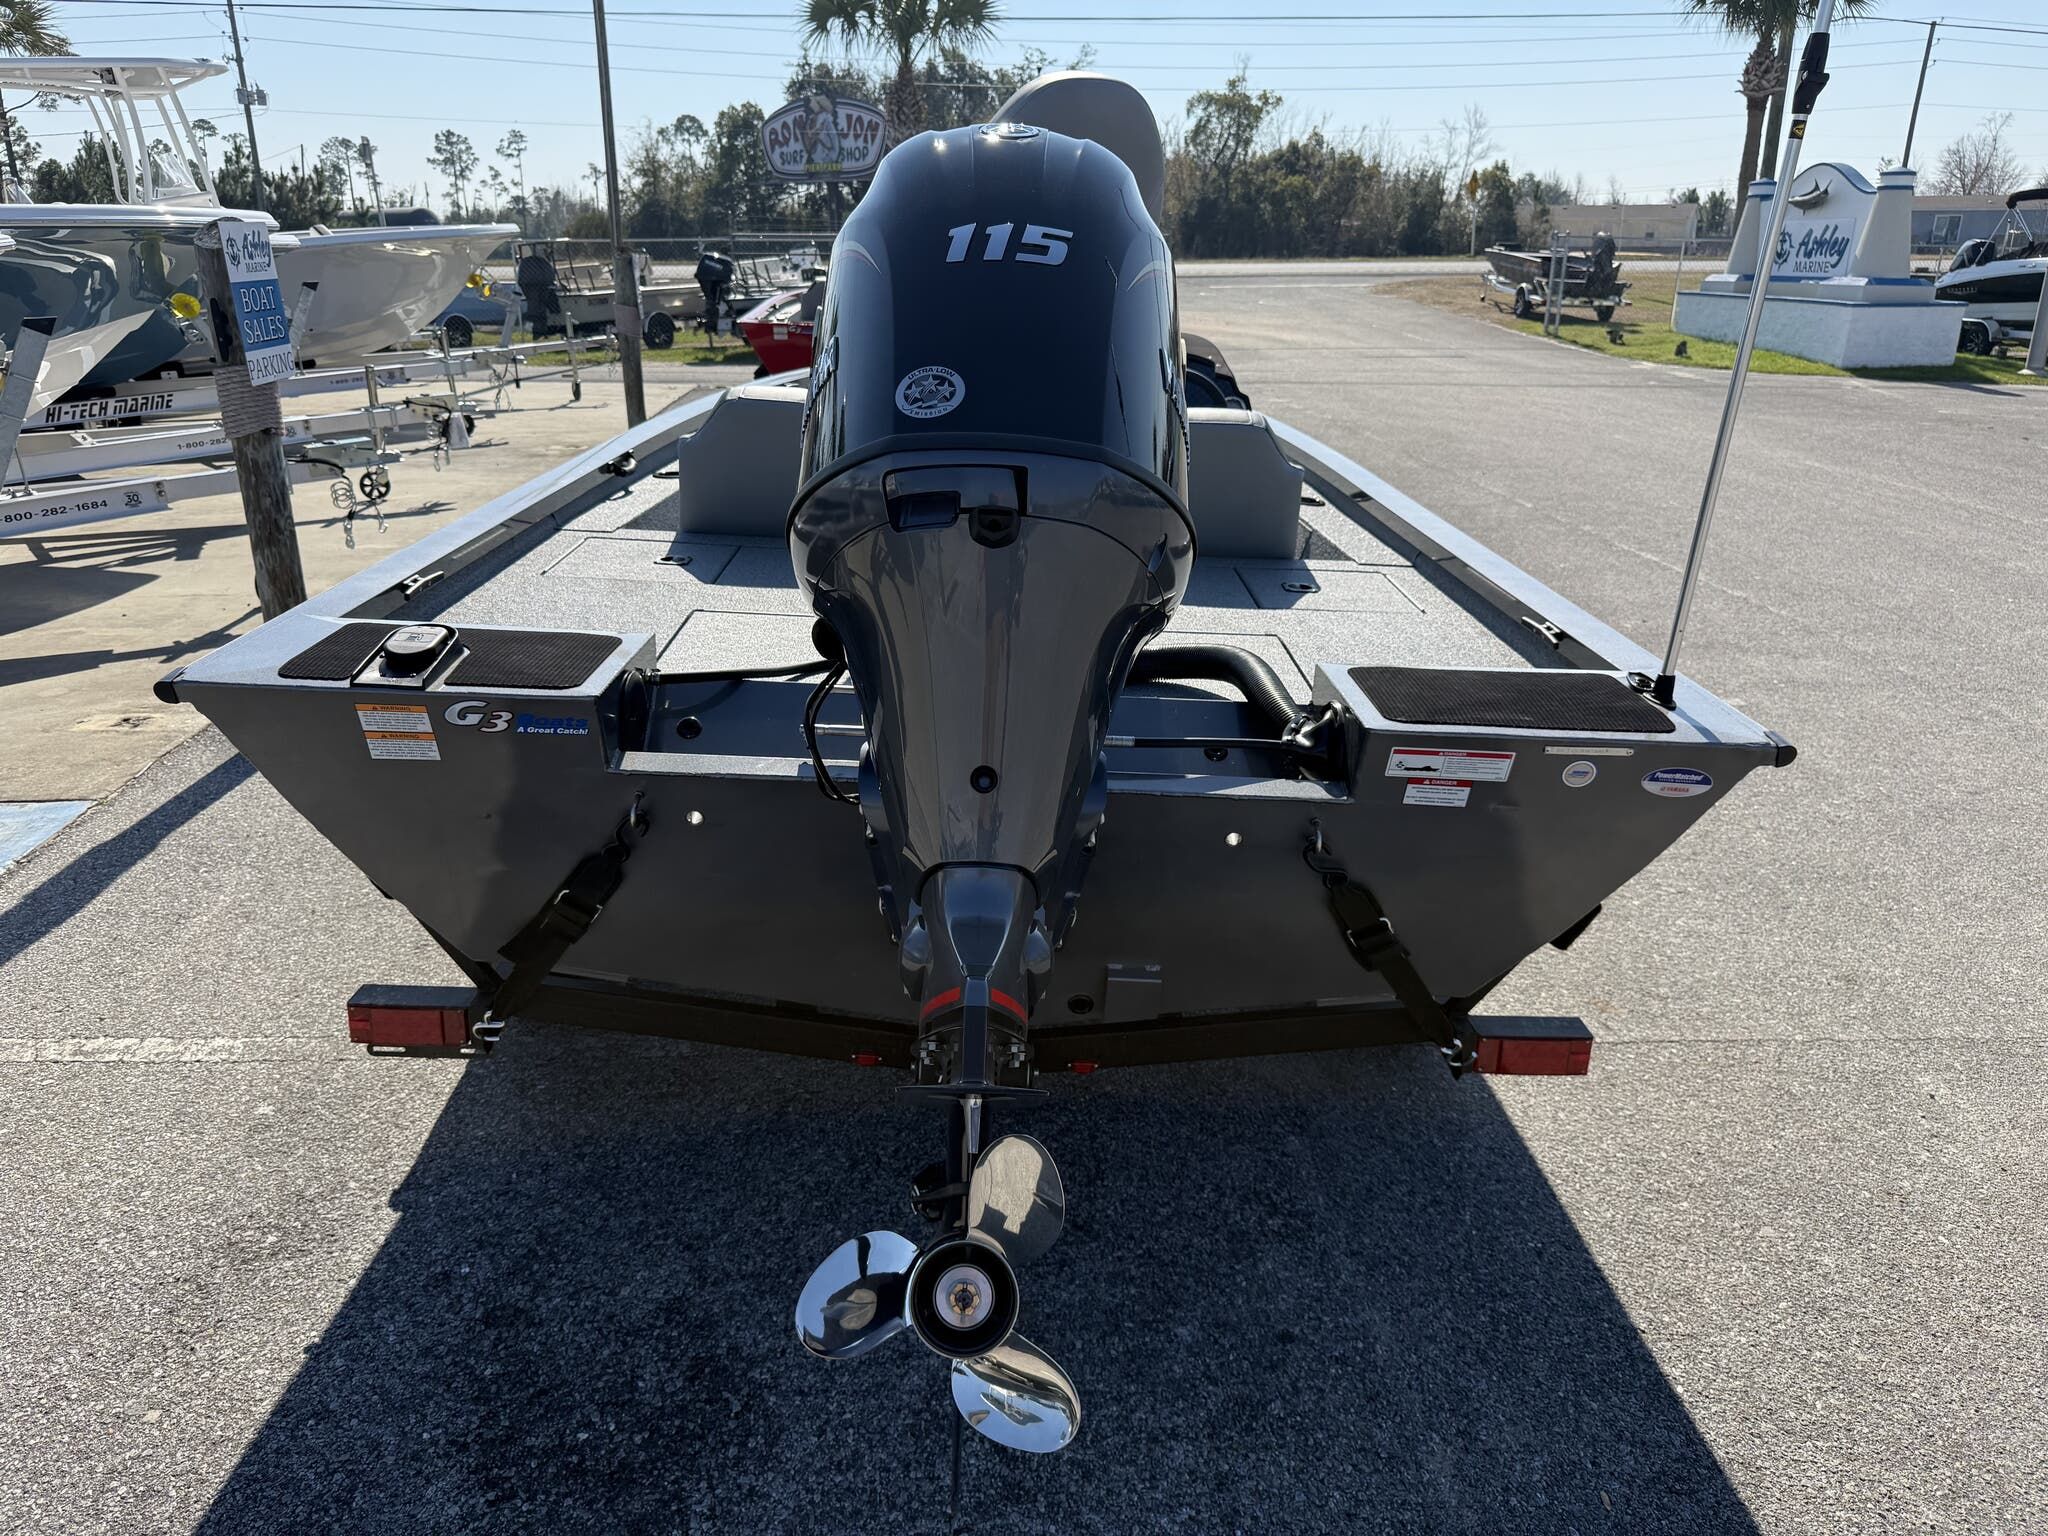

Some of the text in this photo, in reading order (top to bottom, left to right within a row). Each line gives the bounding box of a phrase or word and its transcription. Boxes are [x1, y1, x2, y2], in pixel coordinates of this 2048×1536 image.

[768, 113, 880, 154] RON JON
[780, 146, 869, 166] SURF SHOP
[242, 229, 272, 268] Ashley
[945, 222, 1074, 266] 115
[1795, 224, 1850, 269] Ashley
[245, 261, 268, 273] MARINE
[1792, 261, 1830, 273] MARINE
[240, 286, 276, 313] BOAT
[243, 315, 285, 344] SALES
[247, 351, 295, 380] PARKING
[45, 393, 173, 423] HI-TECH MARINE
[126, 493, 140, 504] 30
[443, 700, 514, 733] G3
[557, 727, 589, 736] Catch!
